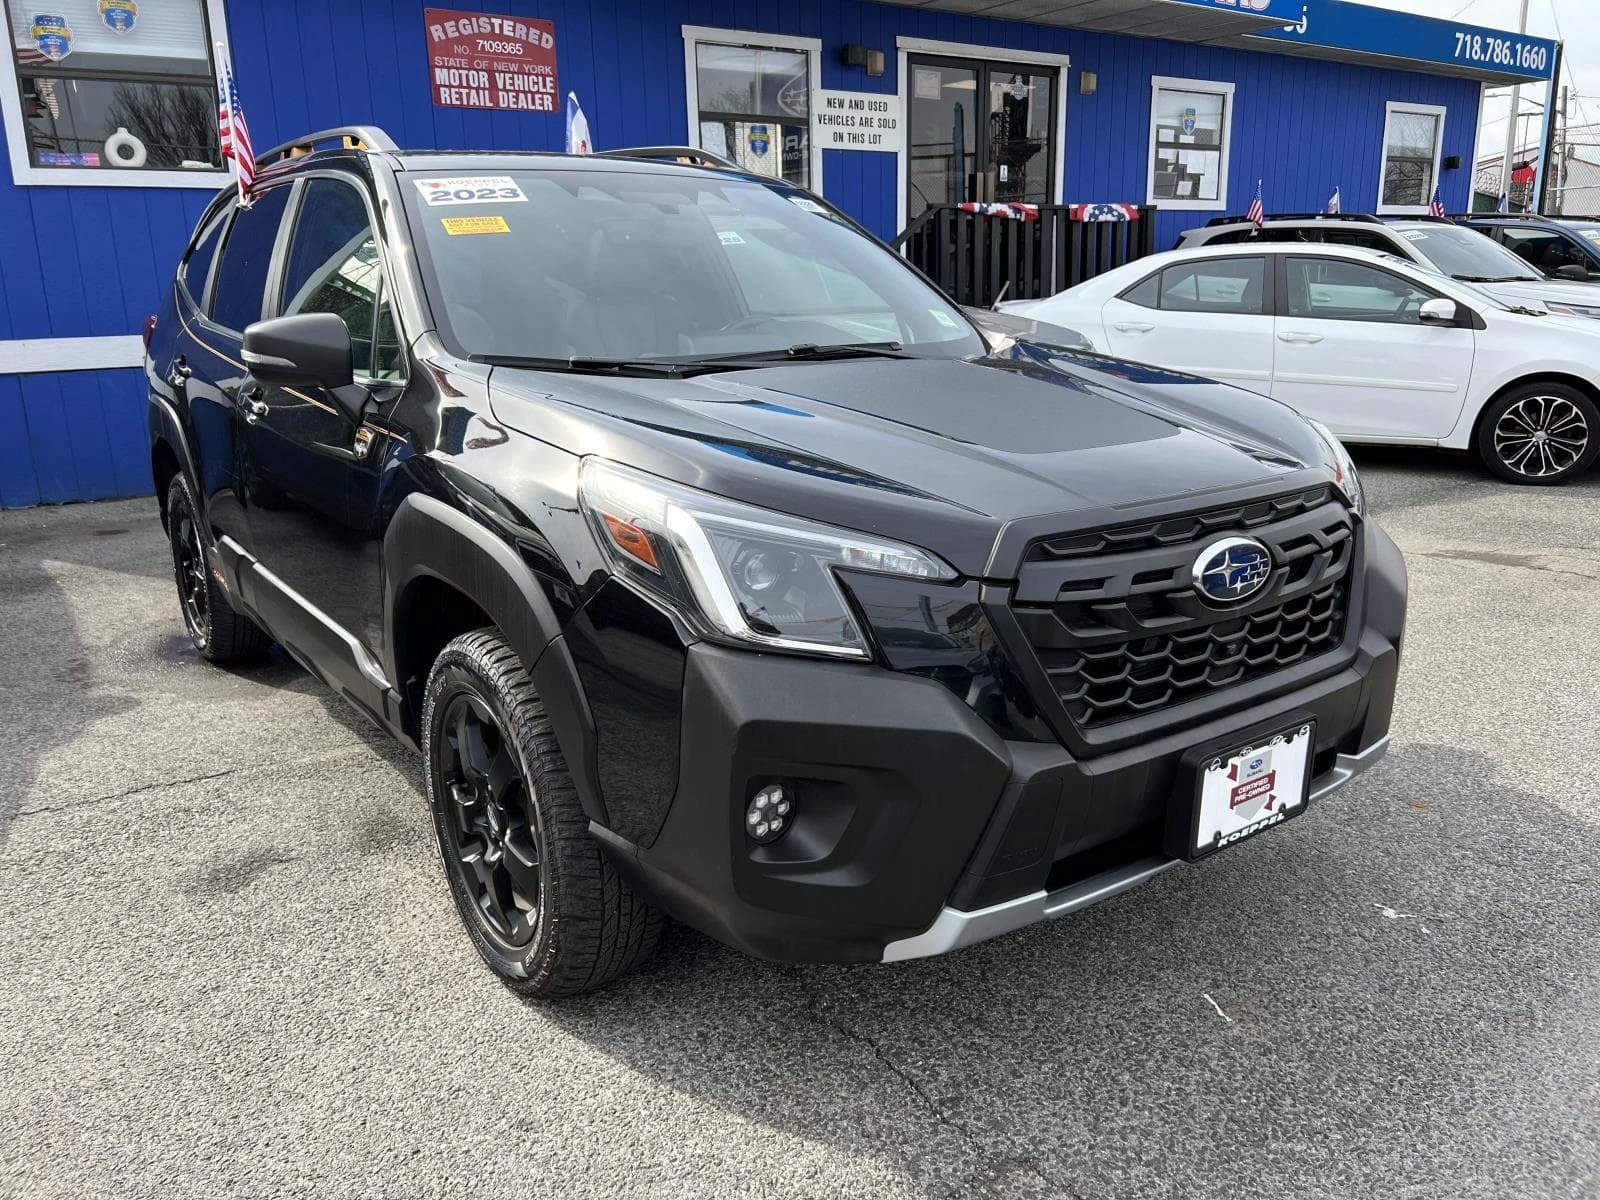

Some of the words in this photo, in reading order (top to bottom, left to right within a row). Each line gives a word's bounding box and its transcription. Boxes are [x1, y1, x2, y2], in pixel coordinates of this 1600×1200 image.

[430, 17, 553, 49] REGISTERED
[453, 44, 472, 55] NO.
[475, 39, 524, 55] 7109365
[1454, 32, 1547, 71] 718.786.1660
[434, 56, 469, 69] STATE
[473, 60, 489, 70] OF
[493, 62, 519, 73] NEW
[522, 63, 553, 75] YORK
[435, 67, 490, 88] MOTOR
[495, 73, 555, 93] VEHICLE
[440, 87, 494, 107] RETAIL
[499, 91, 553, 111] DEALER
[826, 97, 845, 109] NEW
[848, 99, 865, 111] AND
[867, 100, 888, 112] USED
[817, 113, 856, 127] VEHICLES
[859, 116, 874, 128] ARE
[877, 118, 897, 129] SOLD
[833, 131, 844, 143] ON
[847, 132, 866, 144] THIS
[868, 133, 882, 144] LOT
[430, 188, 520, 202] 2023
[1234, 783, 1271, 803] PRE-OWNED
[1238, 777, 1269, 794] CERTIFIED
[1217, 812, 1285, 848] KOEPPEL
